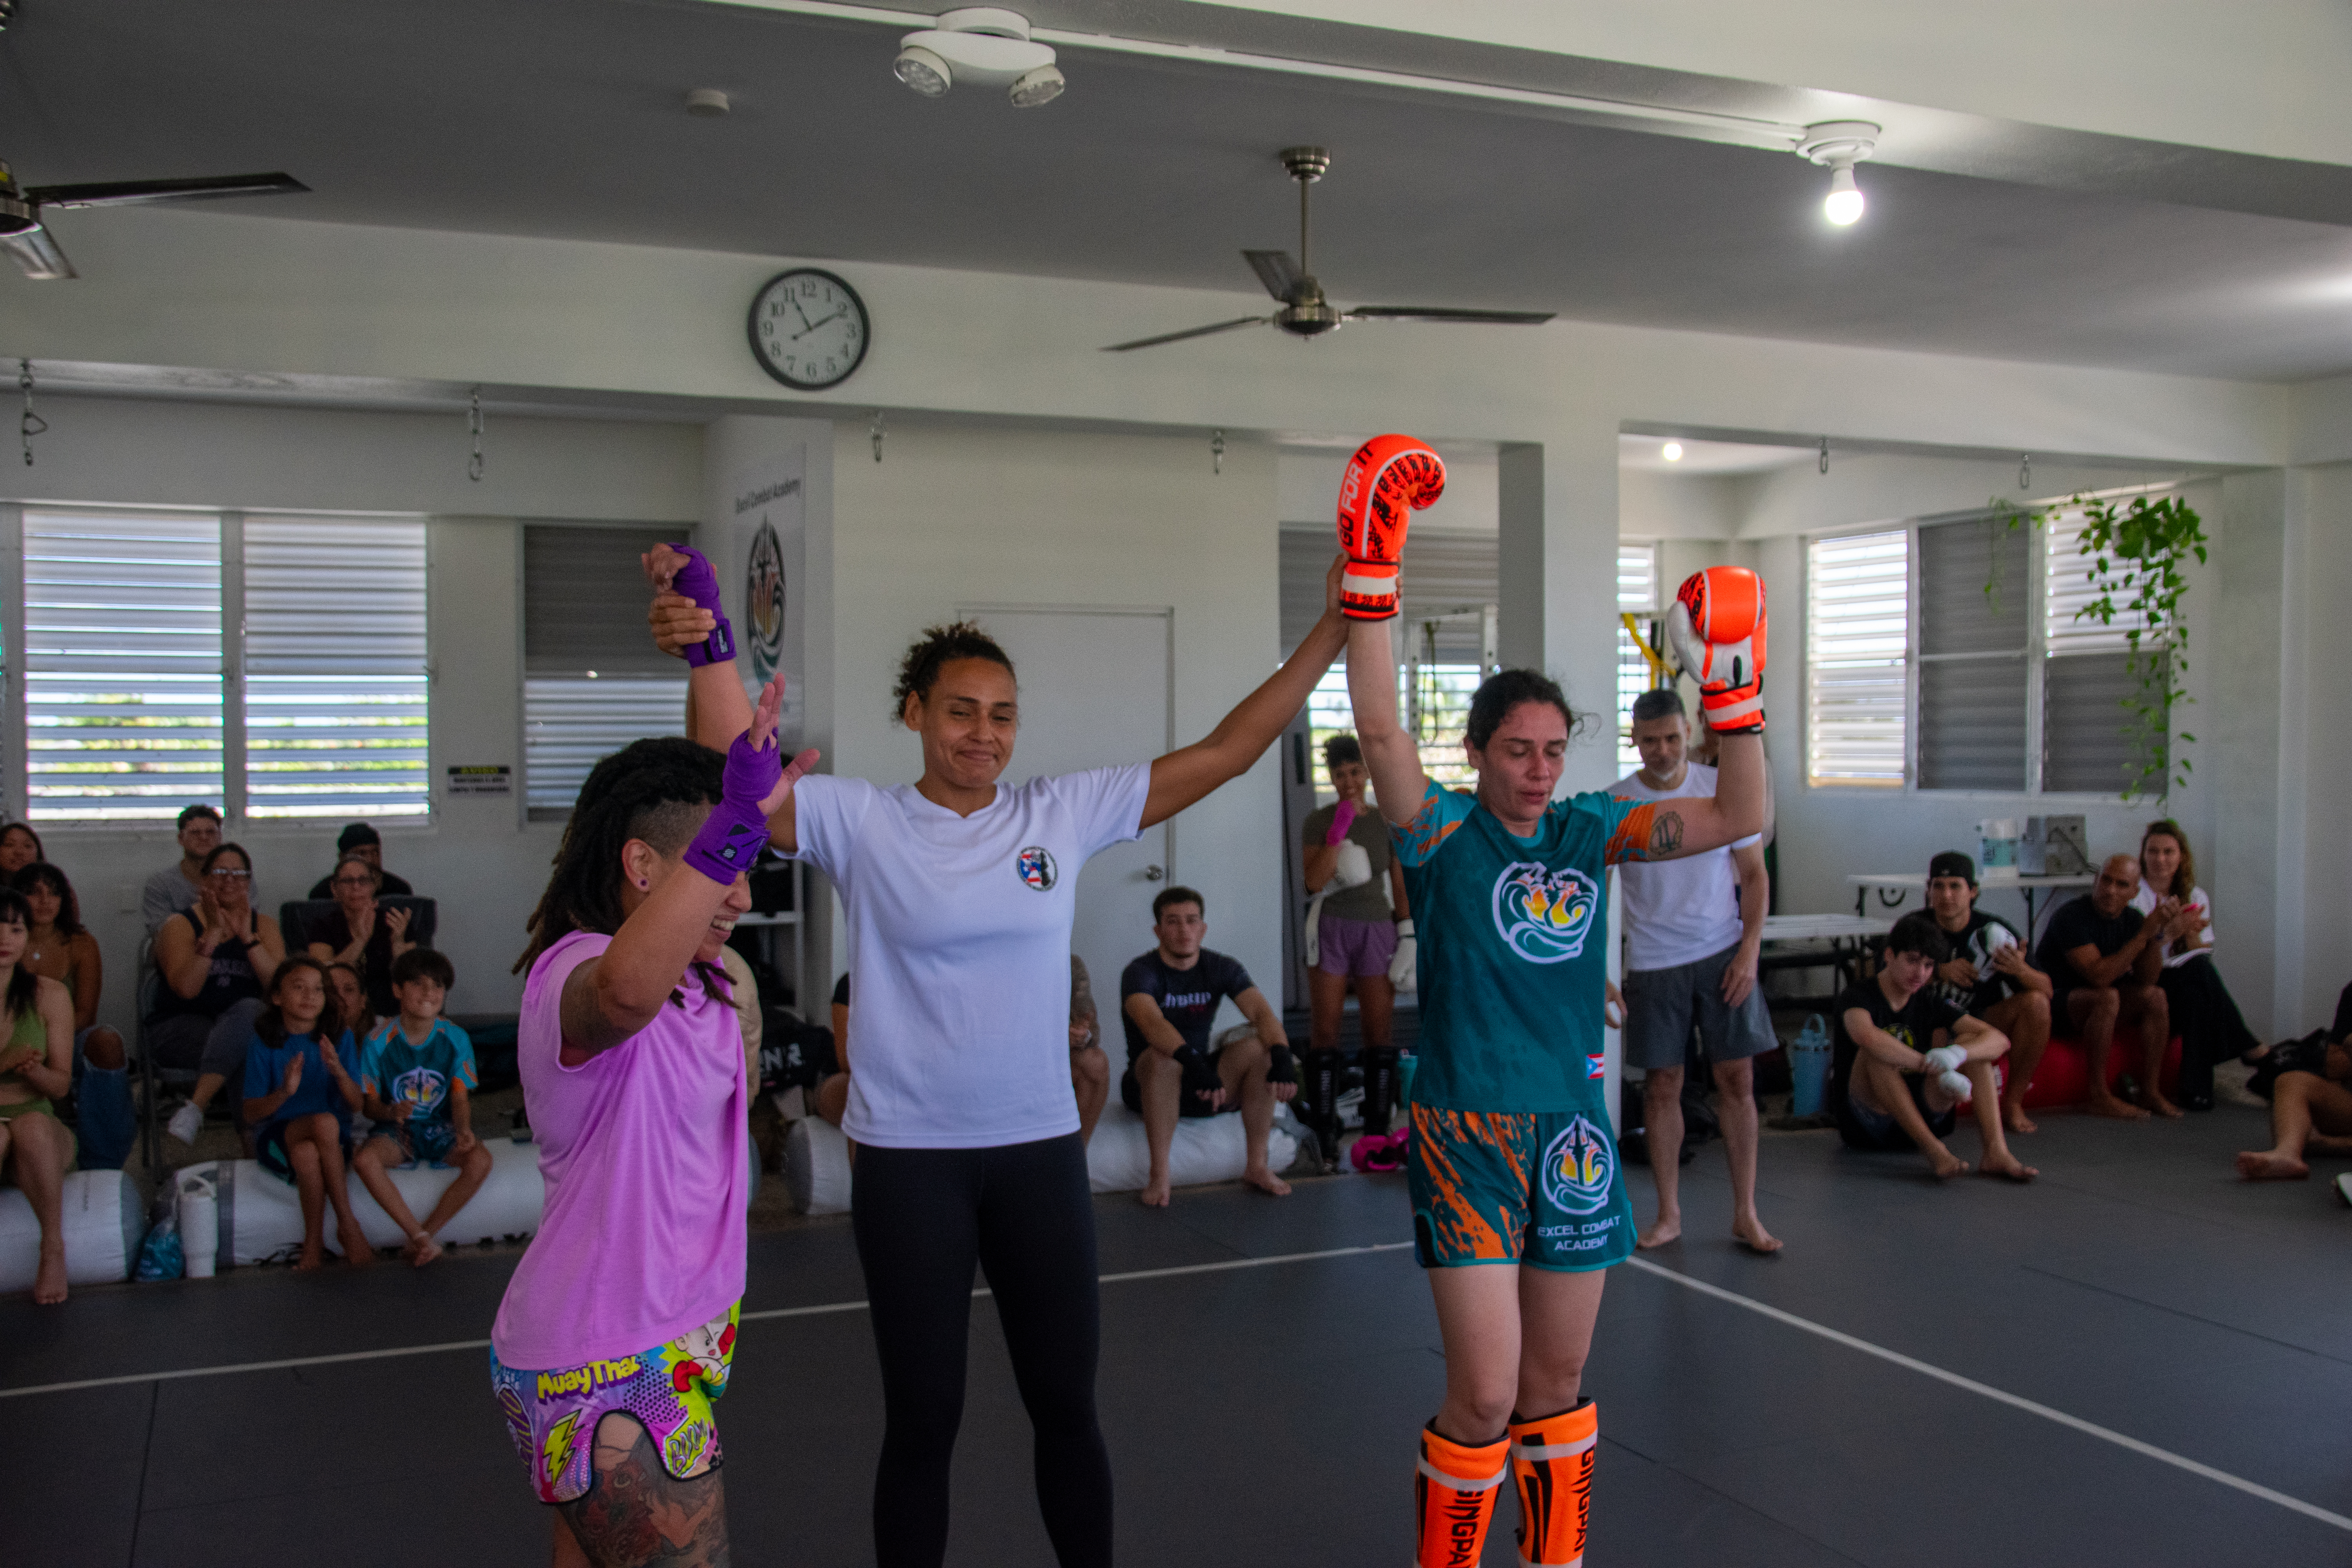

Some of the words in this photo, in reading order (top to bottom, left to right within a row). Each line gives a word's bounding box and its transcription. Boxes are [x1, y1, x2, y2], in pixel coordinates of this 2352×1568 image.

[784, 287, 795, 303] 11
[801, 281, 817, 298] 12
[826, 287, 831, 303] 1
[771, 301, 785, 317] 10
[837, 302, 848, 318] 2
[762, 321, 774, 336] 9
[846, 322, 856, 339] 3
[771, 341, 781, 357] 8
[841, 343, 849, 358] 4
[786, 355, 796, 372] 7
[806, 361, 817, 377] 6
[827, 357, 837, 372] 5
[1356, 443, 1373, 465] IT
[1341, 462, 1364, 514] FOR
[1339, 512, 1354, 547] GO
[1537, 1224, 1579, 1237] EXCEL
[1581, 1215, 1621, 1235] COMBAT
[1554, 1233, 1608, 1251] ACADEMY
